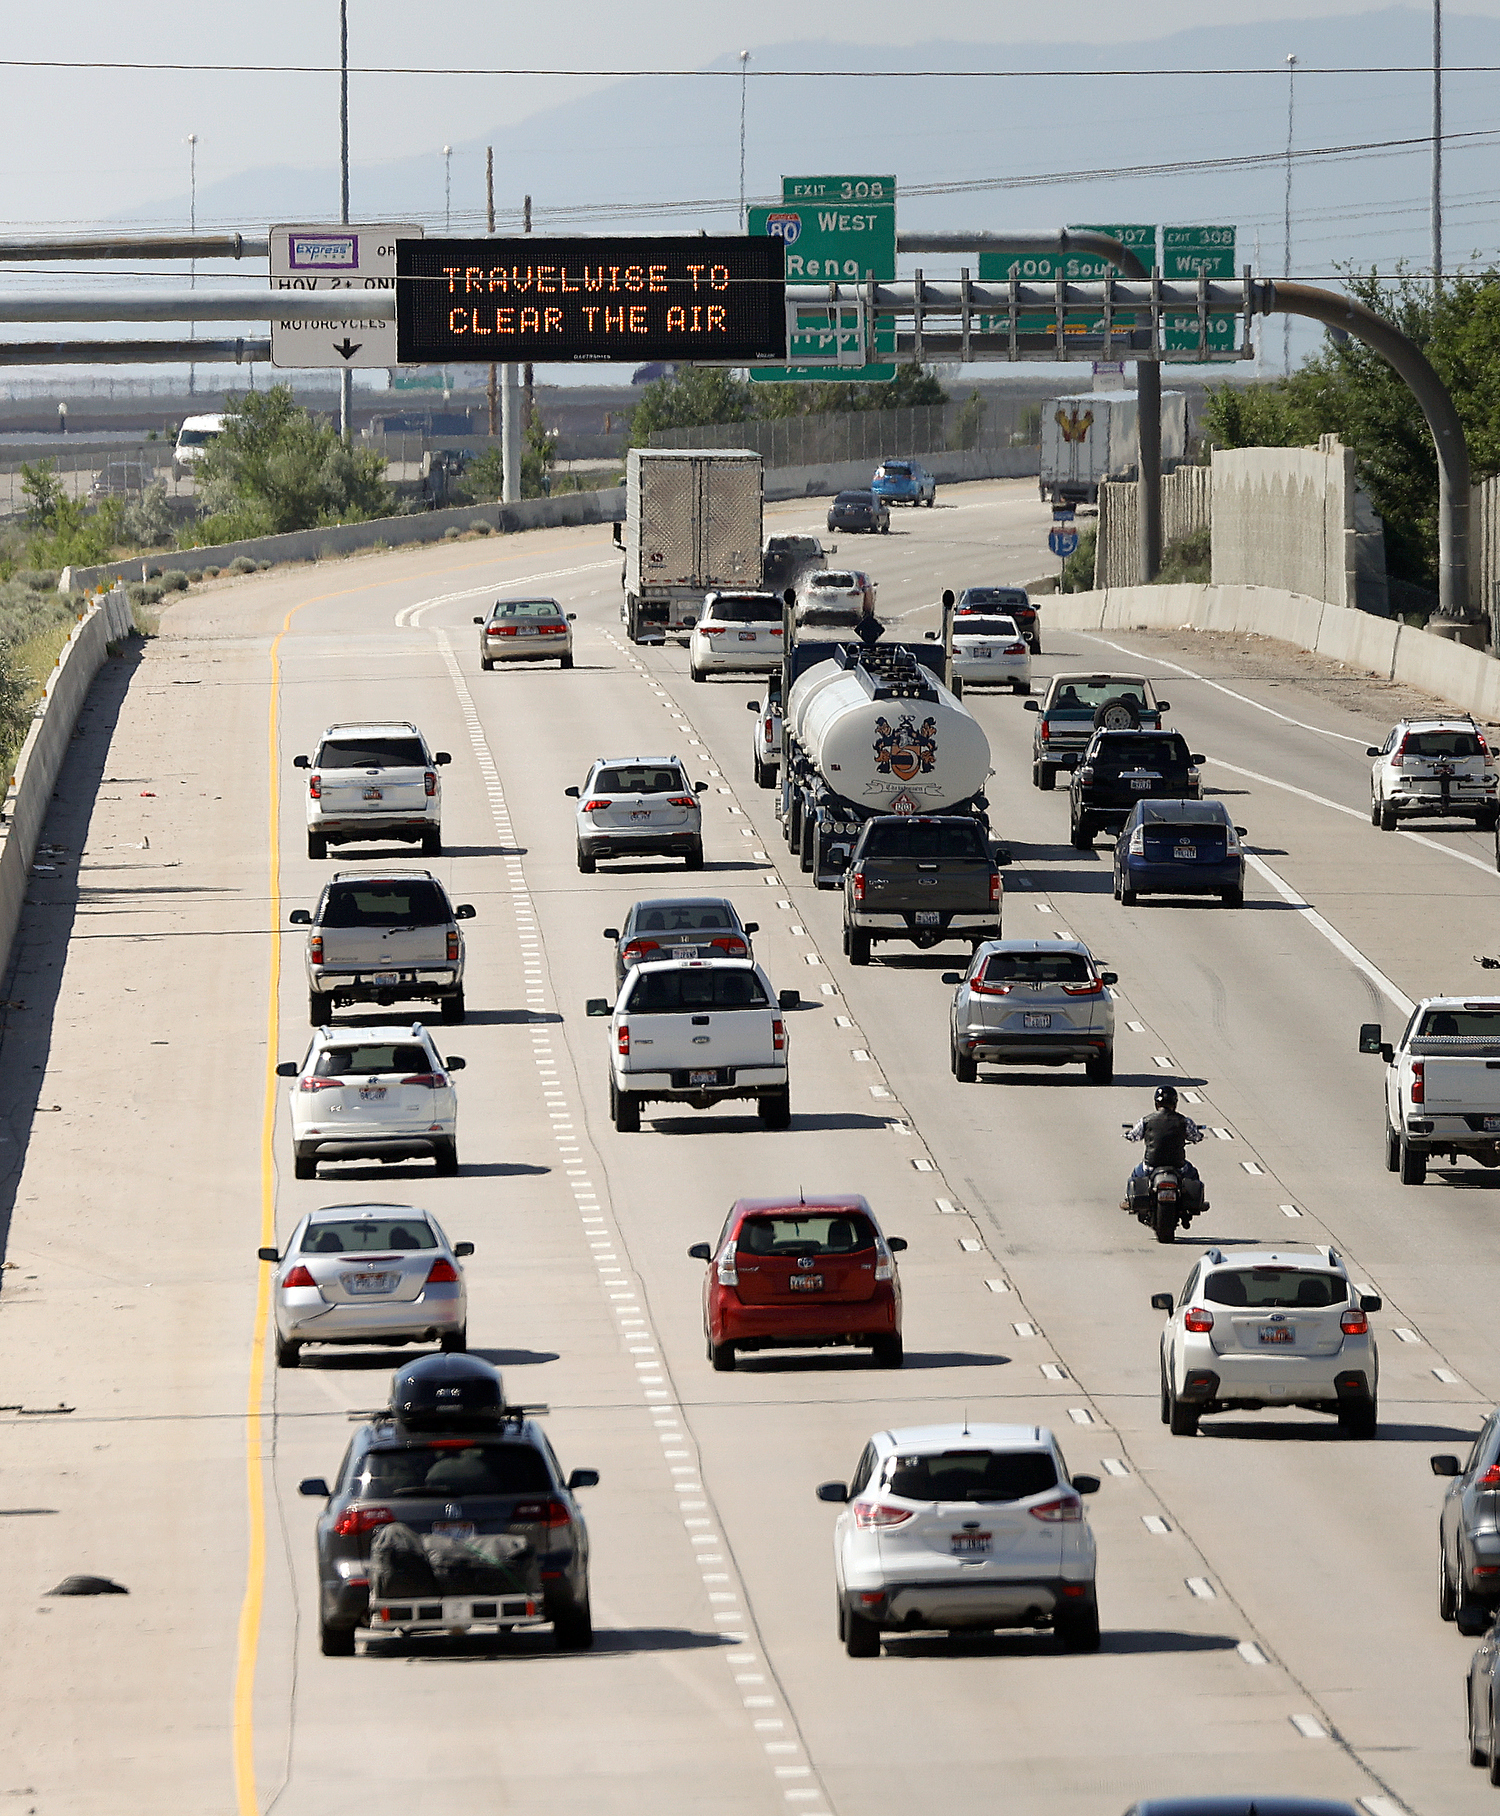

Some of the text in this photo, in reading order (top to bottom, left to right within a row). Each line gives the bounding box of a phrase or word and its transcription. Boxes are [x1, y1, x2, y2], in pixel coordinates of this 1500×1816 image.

[794, 181, 883, 200] EXIT 308
[771, 211, 877, 242] 80 WEST
[1114, 229, 1147, 242] 307
[1167, 230, 1233, 245] EXIT 308
[296, 243, 348, 260] Express
[787, 254, 859, 277] Reno
[1007, 259, 1051, 276] 400
[1175, 255, 1222, 273] WEST
[279, 278, 318, 290] HOV
[442, 264, 730, 293] TRAVELWISE TO
[280, 320, 386, 331] MOTORCYCLES
[449, 304, 728, 335] CLEAR THE AIR
[1054, 534, 1074, 552] 15
